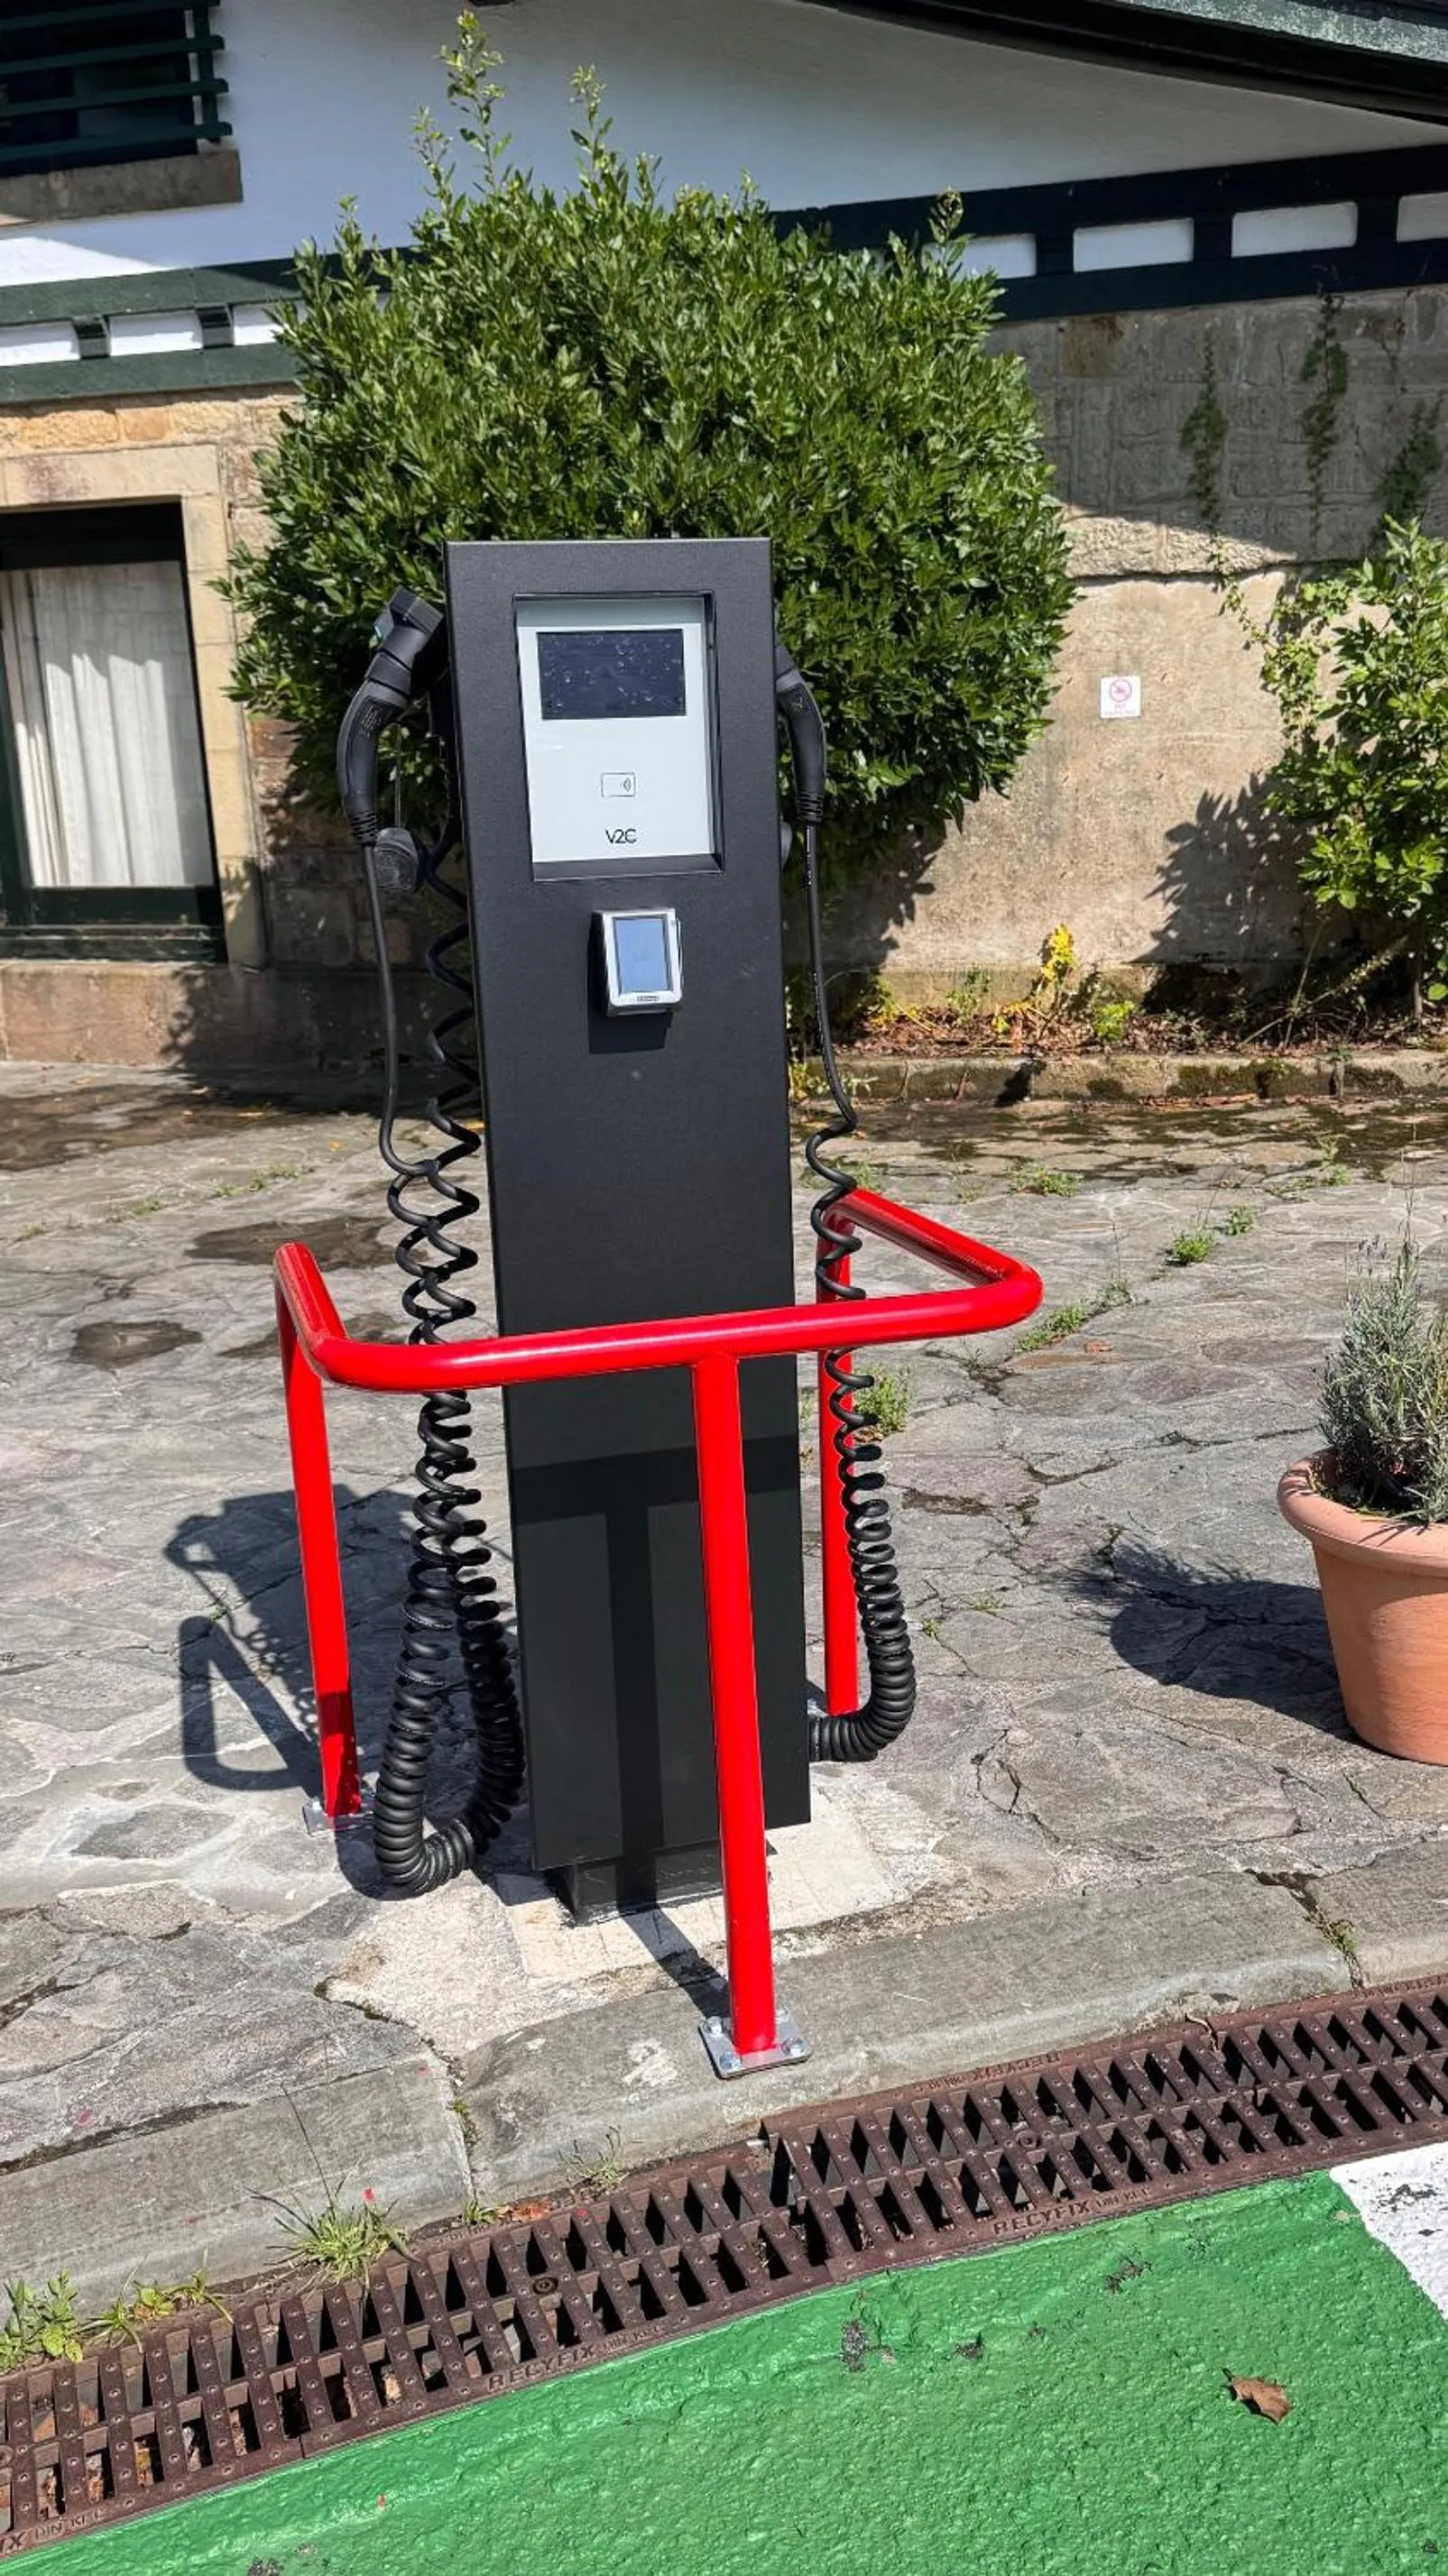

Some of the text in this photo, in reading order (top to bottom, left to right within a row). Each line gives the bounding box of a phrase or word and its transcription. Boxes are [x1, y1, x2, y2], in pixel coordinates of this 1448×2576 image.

[604, 827, 637, 844] V2C
[992, 2199, 1090, 2235] RECYFIX
[488, 2344, 598, 2391] RECYFIX
